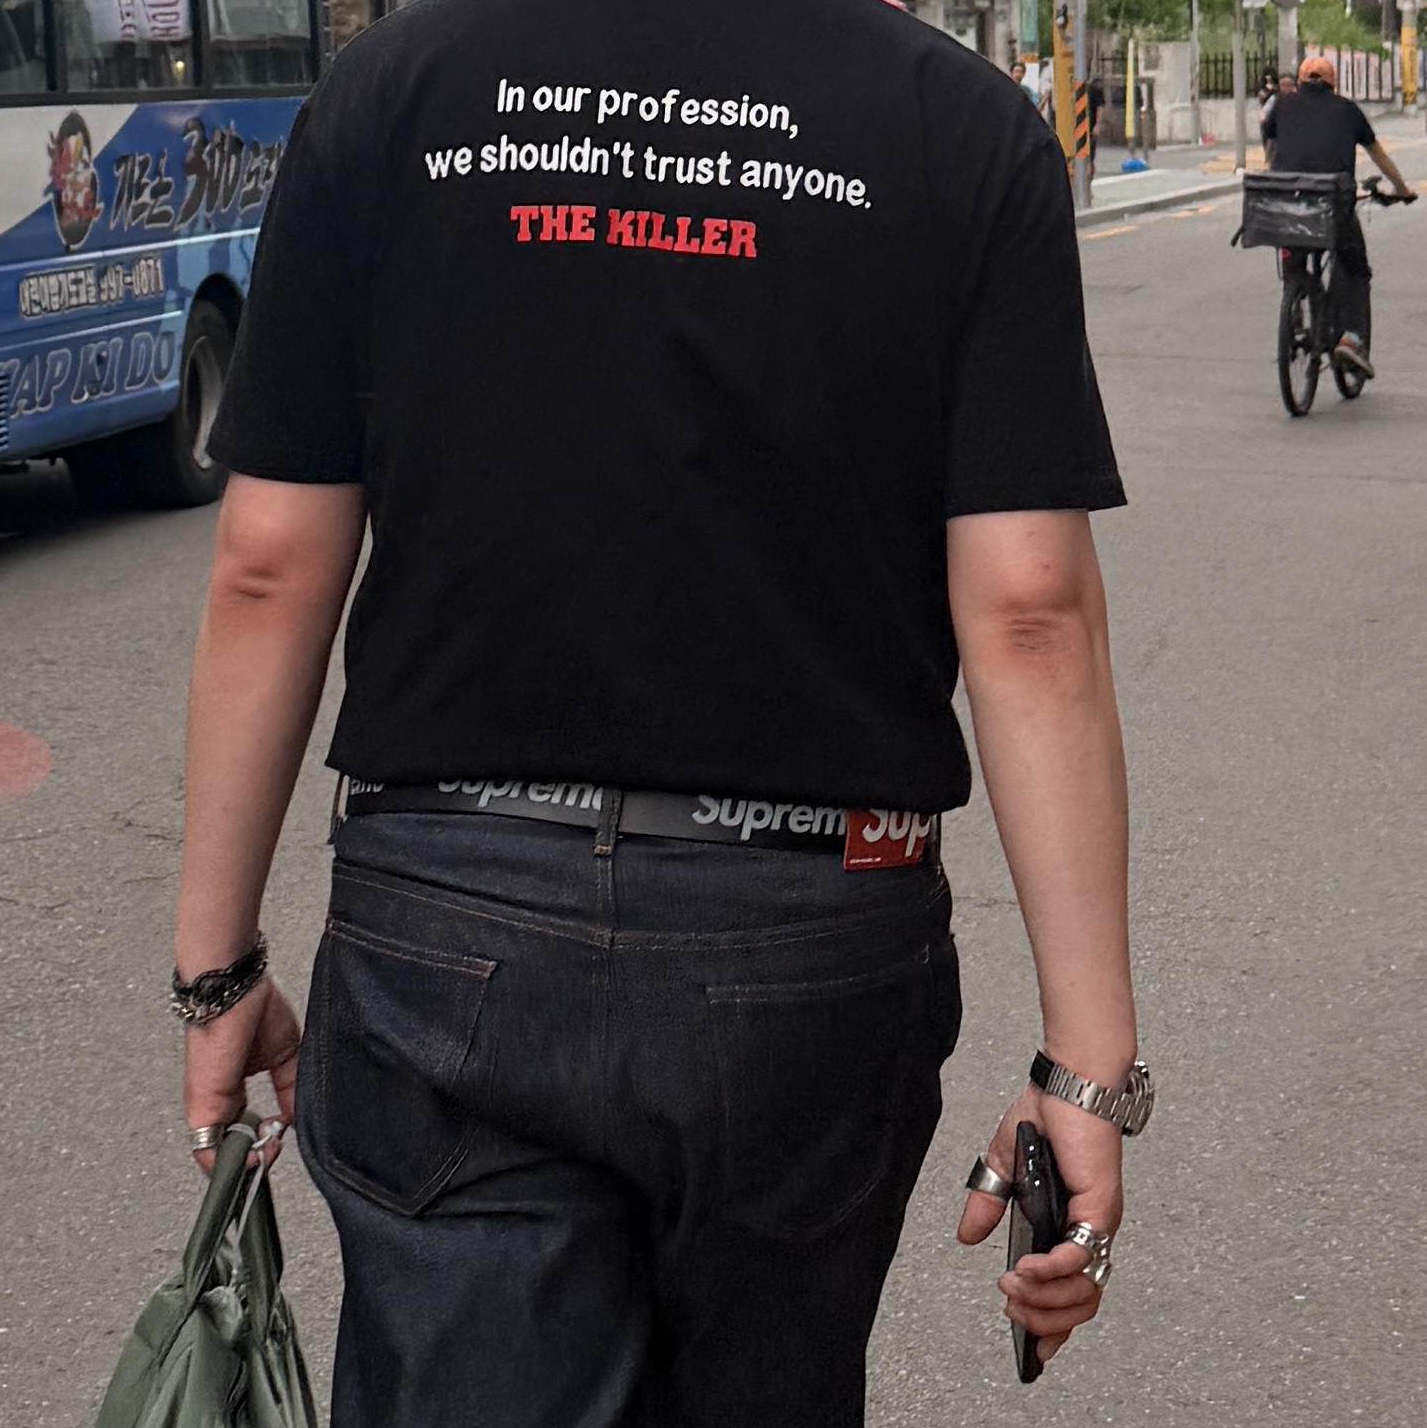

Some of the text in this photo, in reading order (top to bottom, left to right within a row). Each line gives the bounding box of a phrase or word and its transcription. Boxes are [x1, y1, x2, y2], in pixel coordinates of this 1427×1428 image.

[496, 78, 525, 113] In
[532, 84, 591, 113] our
[424, 135, 872, 210] we shouldn't trust anyone.
[509, 205, 758, 258] THE KILLER
